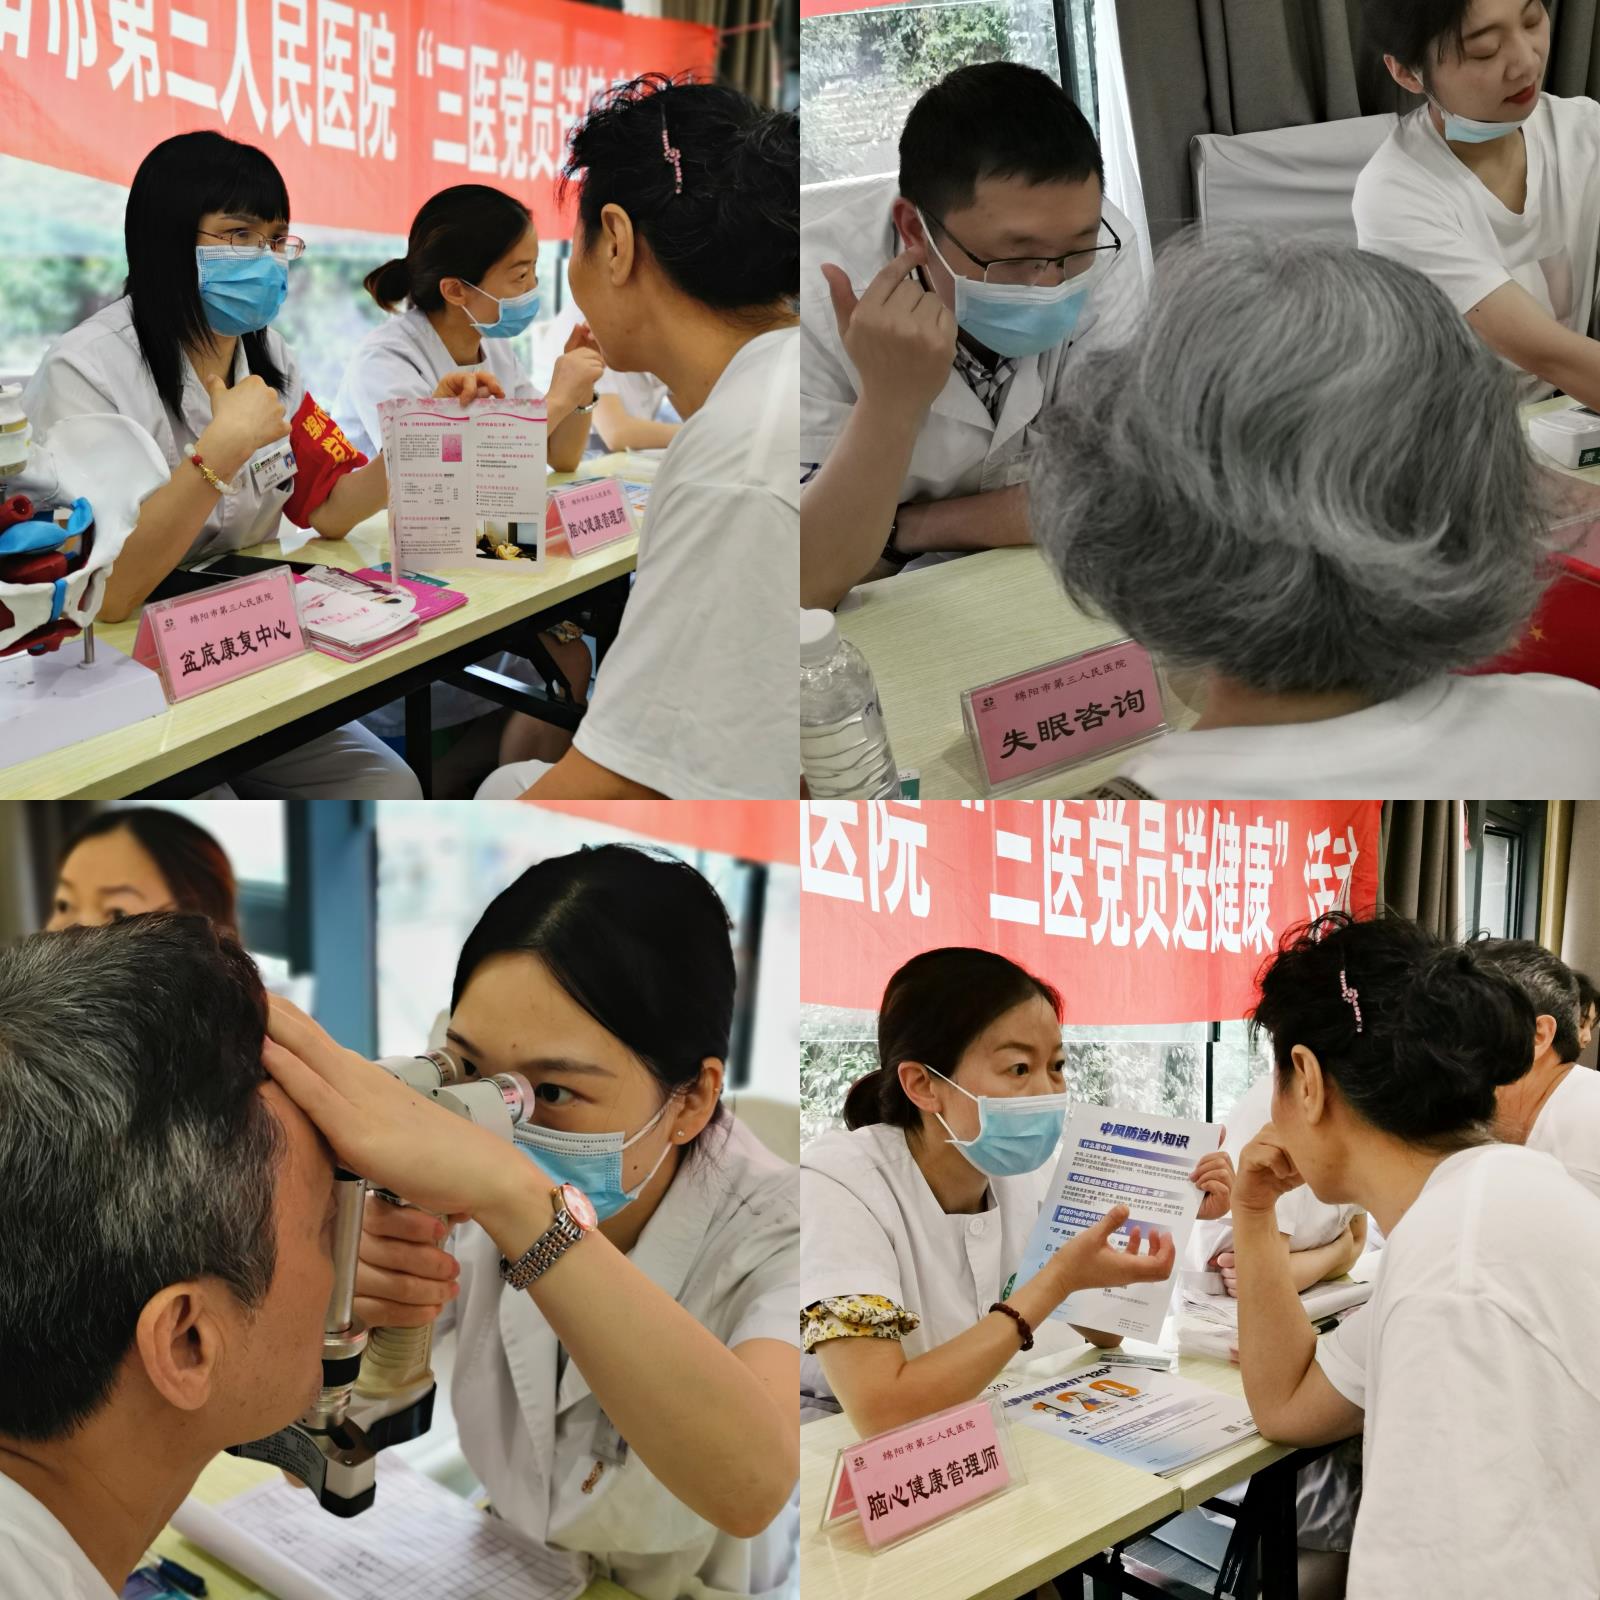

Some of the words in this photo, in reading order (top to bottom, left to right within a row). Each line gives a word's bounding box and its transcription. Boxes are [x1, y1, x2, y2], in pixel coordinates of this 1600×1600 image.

[568, 507, 626, 539] 脑心健康管理师
[189, 592, 274, 624] 绵阳市第三人民医院
[179, 619, 292, 677] 盆底康复中心
[1014, 659, 1128, 702] 绵阳市第三人民医院
[1000, 689, 1145, 759] 失眠咨询
[800, 800, 931, 919] 医院
[961, 800, 1289, 955] 三医党员送健康”
[1082, 1140, 1113, 1152] 什么是中风
[1099, 1121, 1190, 1149] 中风防治小知识
[881, 1419, 976, 1462] 绵阳市第三人民医院
[866, 1444, 1000, 1521] 脑心健康管理师
